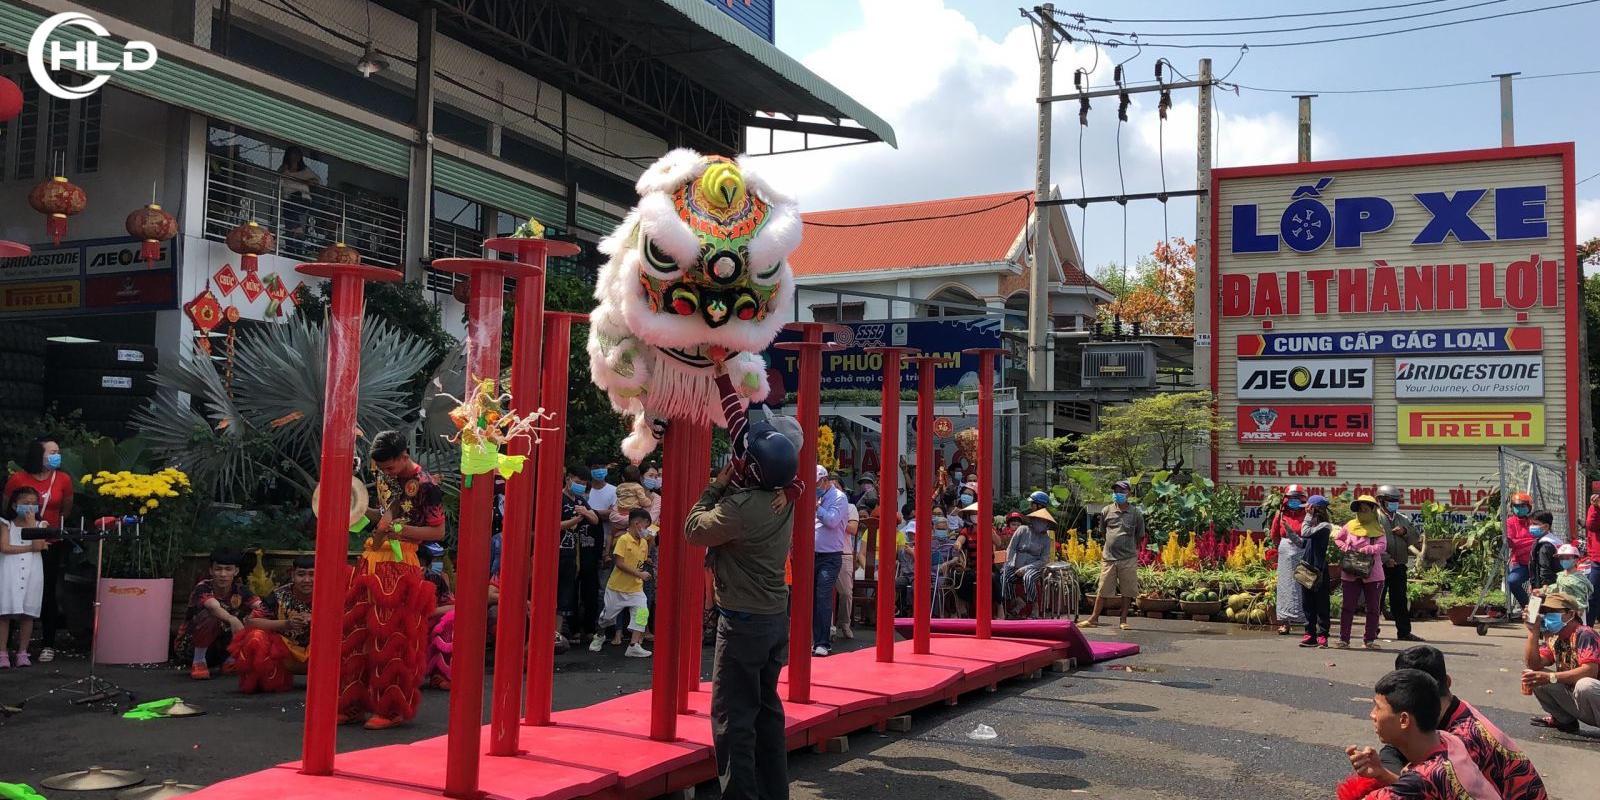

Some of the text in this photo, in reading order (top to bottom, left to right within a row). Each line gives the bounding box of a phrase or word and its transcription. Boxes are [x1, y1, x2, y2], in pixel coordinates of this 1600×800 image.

[1231, 176, 1550, 254] LỐP XE
[1221, 253, 1560, 330] ĐẠI THÀNH LỢI
[855, 323, 886, 341] SSSC
[1274, 329, 1496, 353] CUNG CẤP CÁC LOẠI
[1241, 365, 1368, 392] AEOLUS
[1396, 362, 1541, 381] BRIDGESTONE
[1405, 382, 1530, 395] Your Journey, Our Passion
[1290, 413, 1338, 431] LỰC
[1409, 411, 1532, 438] PIRELLI
[1287, 454, 1315, 477] LỐP
[1318, 460, 1337, 477] XE
